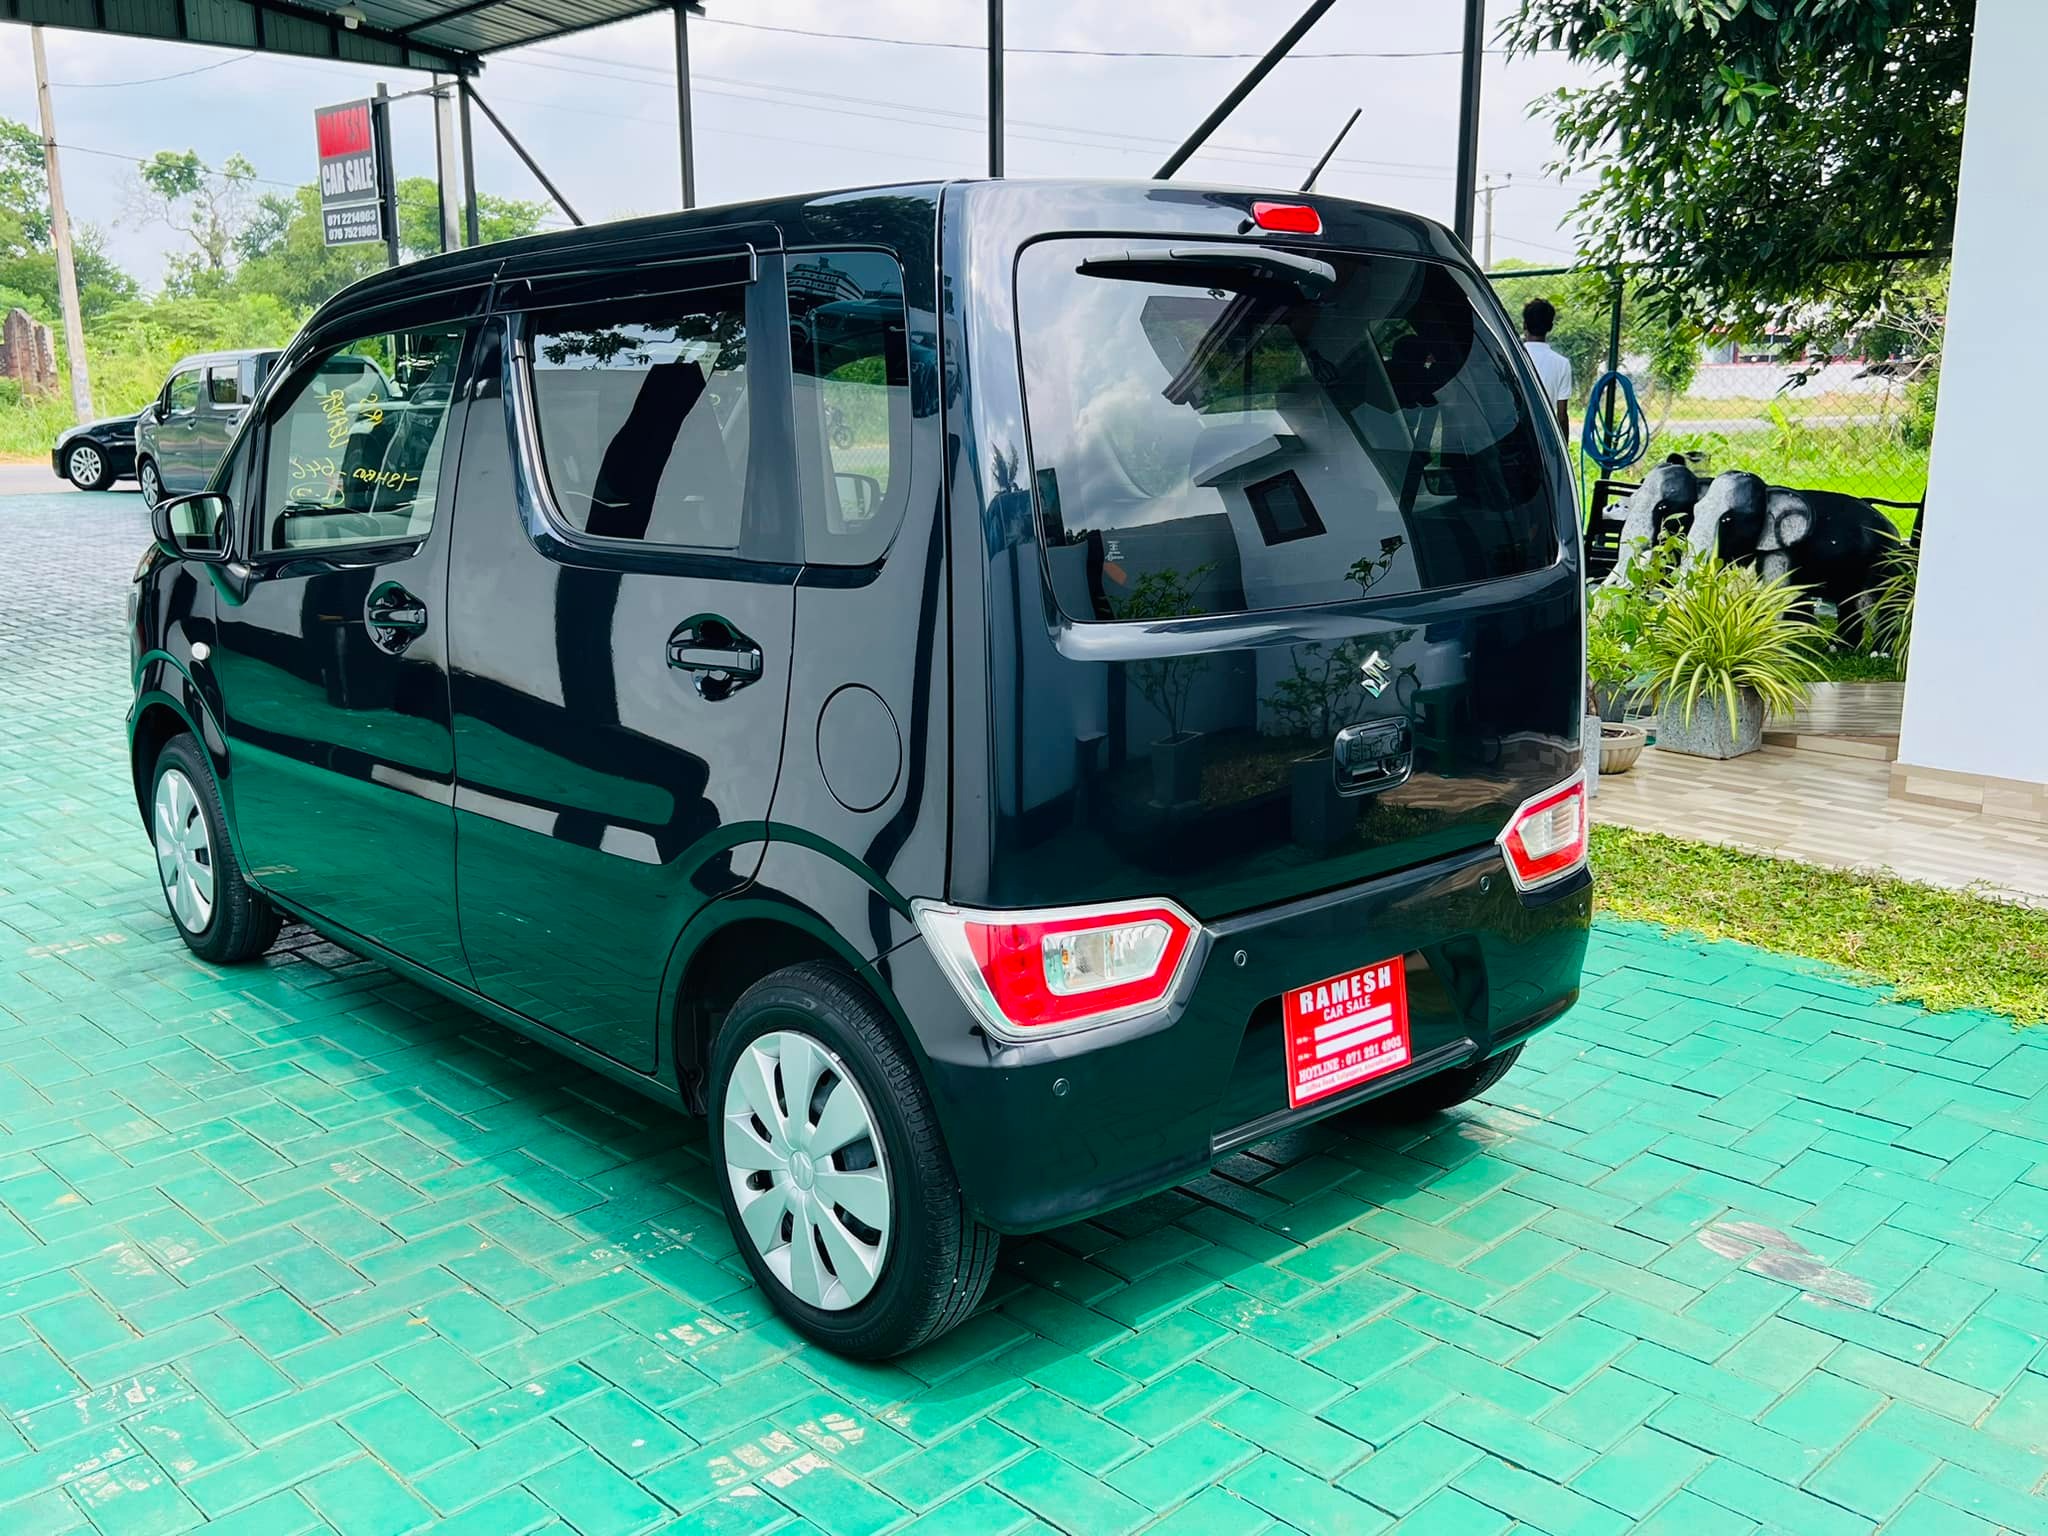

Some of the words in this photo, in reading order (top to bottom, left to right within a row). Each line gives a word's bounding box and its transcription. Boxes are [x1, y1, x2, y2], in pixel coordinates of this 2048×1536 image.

[322, 162, 345, 197] CAR
[345, 157, 373, 193] SALE
[327, 214, 341, 227] 071
[1299, 965, 1391, 1015] RAMESH
[1323, 1003, 1344, 1021] CAR
[1346, 995, 1371, 1014] SALE
[1298, 1057, 1340, 1083] HOTLINE
[1345, 1049, 1363, 1066] 071
